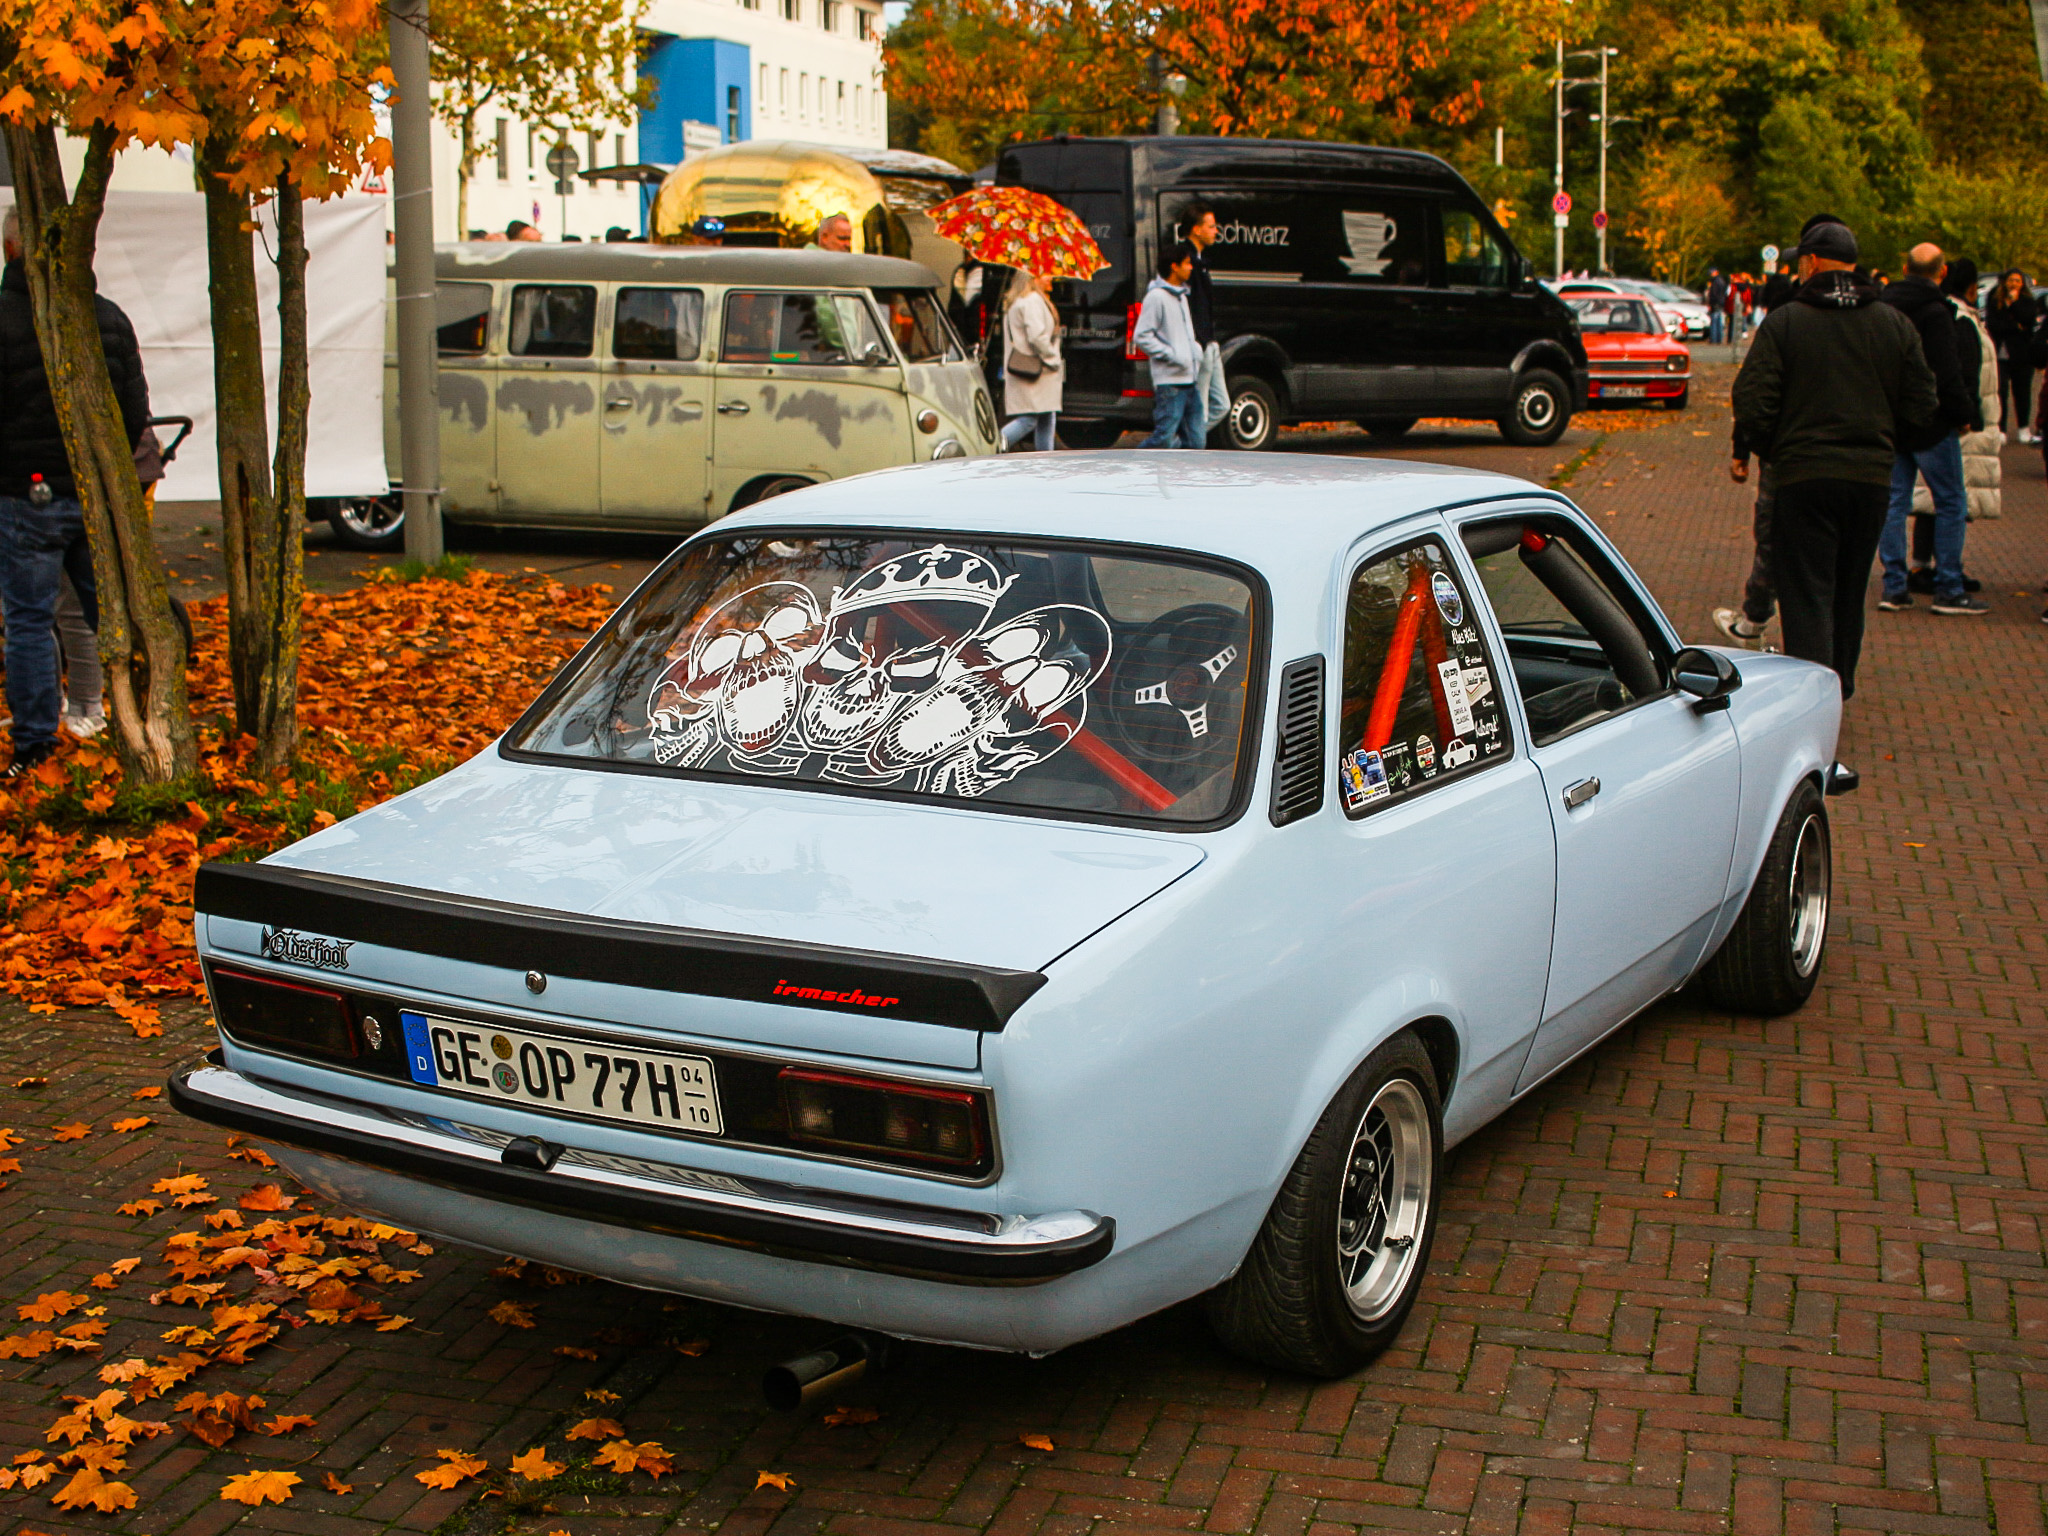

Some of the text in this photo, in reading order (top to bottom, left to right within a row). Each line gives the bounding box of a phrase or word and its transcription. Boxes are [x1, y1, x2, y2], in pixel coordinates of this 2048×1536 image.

[1173, 219, 1290, 247] pschwarz
[269, 929, 356, 969] Oldschool
[773, 979, 899, 1007] irmscher
[417, 1055, 428, 1071] D
[431, 1026, 681, 1120] GE OP 77H
[680, 1066, 703, 1084] 04
[688, 1105, 710, 1124] 10
